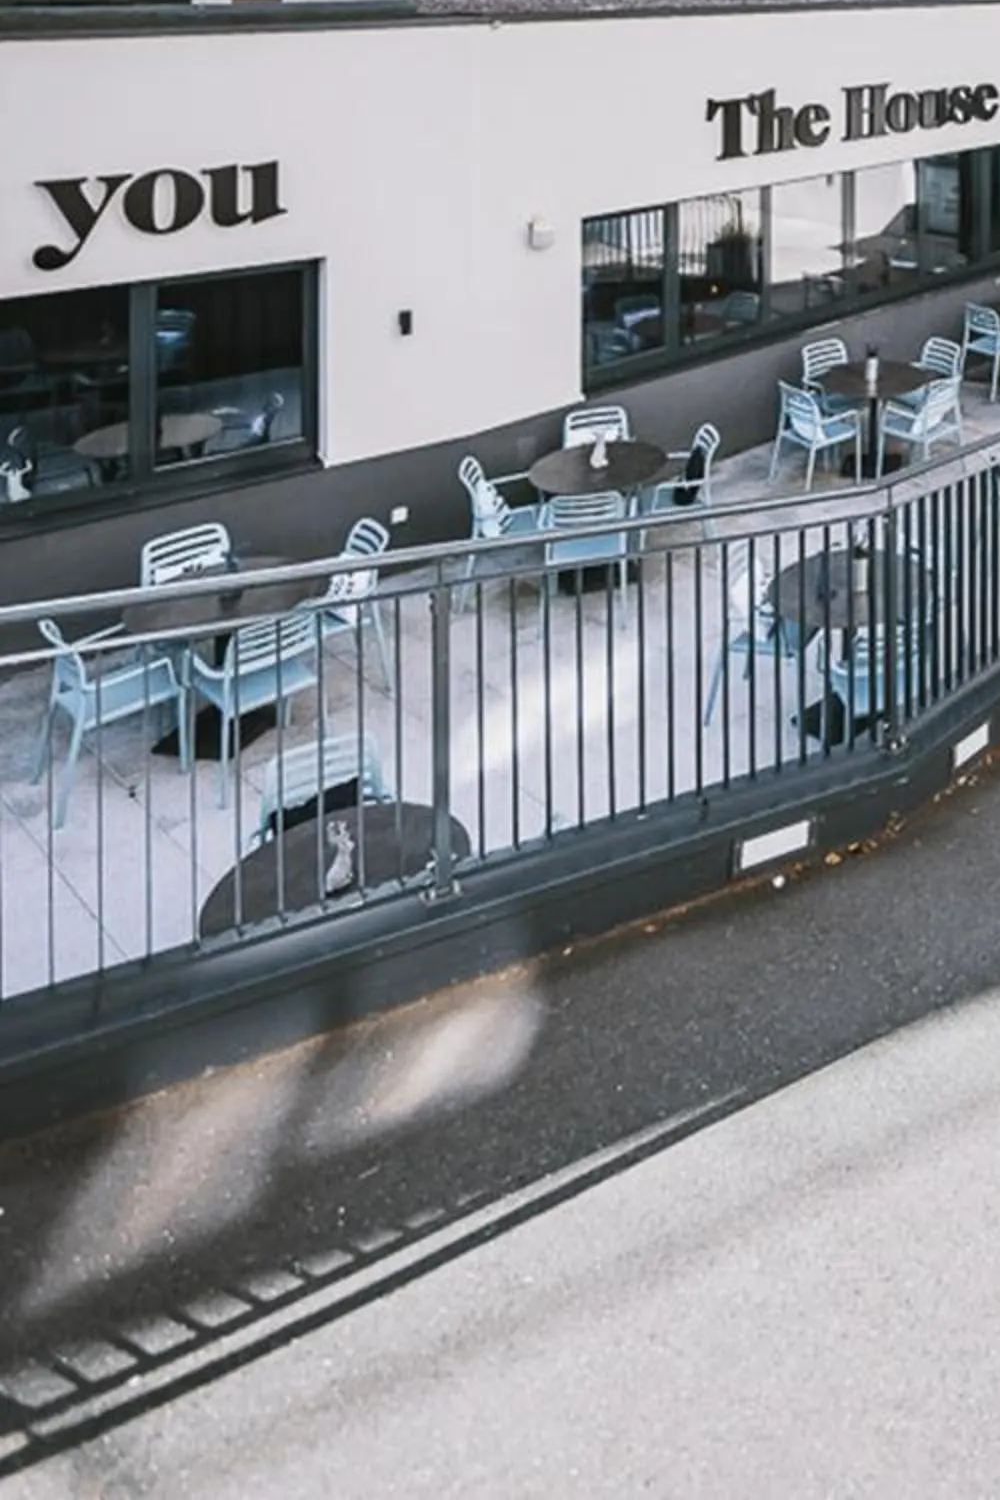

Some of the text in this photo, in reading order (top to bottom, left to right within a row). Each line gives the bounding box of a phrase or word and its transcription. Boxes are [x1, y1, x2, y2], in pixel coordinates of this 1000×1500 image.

[706, 82, 999, 161] The House
[33, 160, 288, 271] you
